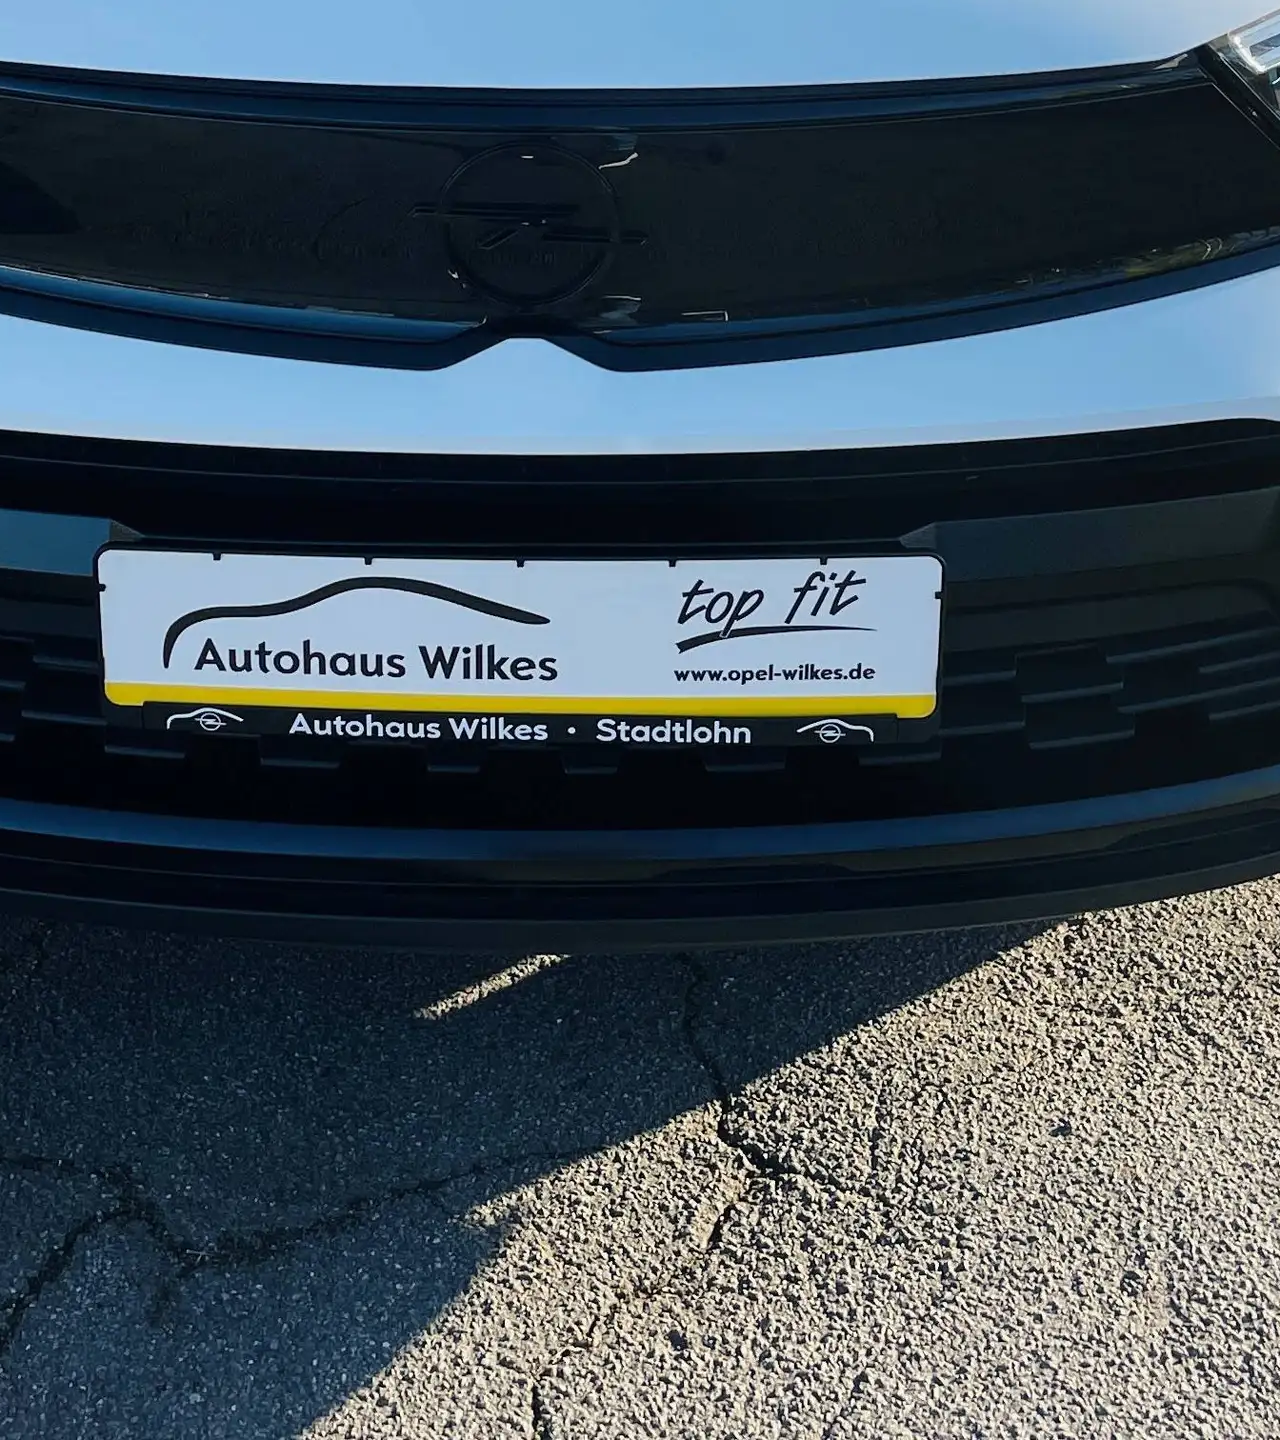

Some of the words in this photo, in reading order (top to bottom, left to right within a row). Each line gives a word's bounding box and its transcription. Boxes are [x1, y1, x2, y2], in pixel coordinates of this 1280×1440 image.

[677, 579, 764, 638] top
[784, 570, 866, 624] fit
[194, 638, 406, 678] Autohaus
[418, 643, 558, 681] Wilkes
[673, 662, 876, 685] www.opel-wilkes.de
[288, 712, 441, 739] Autohaus
[448, 717, 548, 741] Wilkes
[596, 718, 752, 744] Stadtlohn
